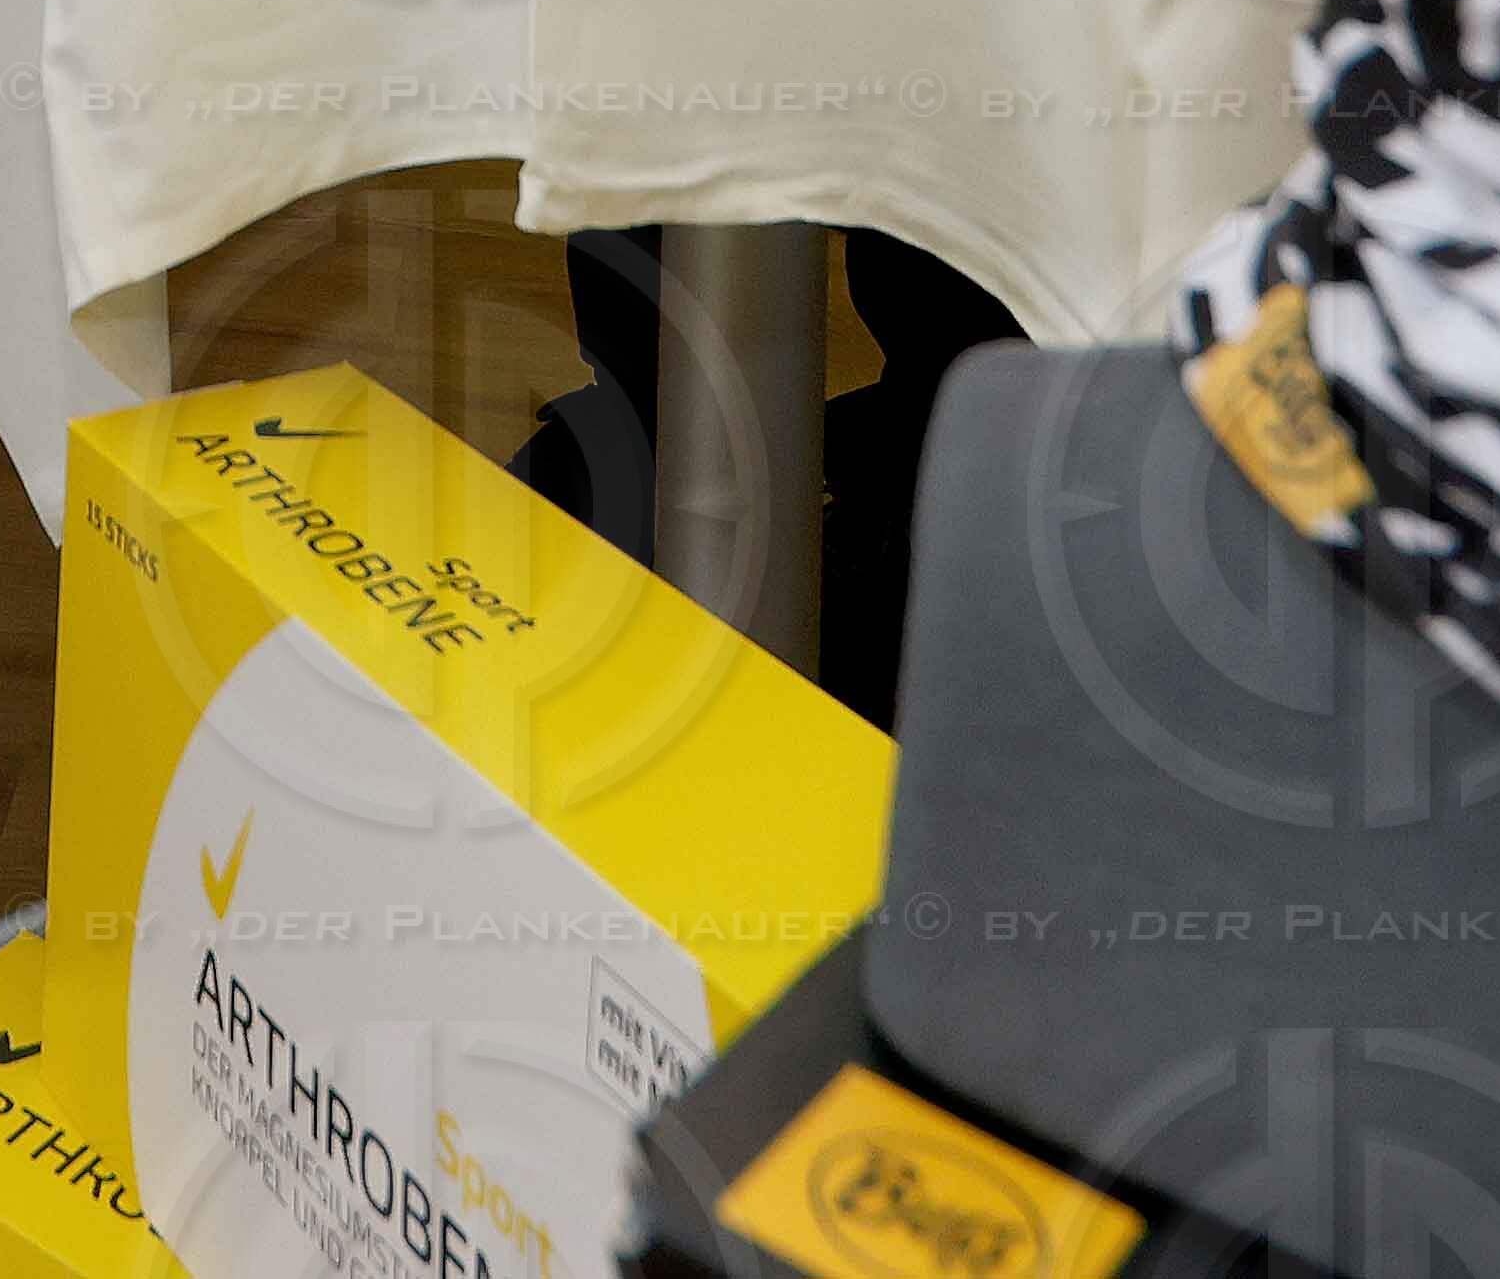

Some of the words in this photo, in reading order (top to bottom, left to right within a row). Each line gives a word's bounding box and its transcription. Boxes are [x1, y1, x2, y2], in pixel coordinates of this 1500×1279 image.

[86, 499, 102, 532] 15
[104, 516, 160, 583] STICKS
[176, 433, 484, 656] ARTHROBENE
[427, 557, 536, 634] Sport
[192, 1020, 232, 1090] DER
[601, 994, 644, 1055] mit
[599, 1038, 640, 1096] mit
[192, 1064, 288, 1209] KNORPEL
[293, 1188, 343, 1269] UND
[436, 1108, 554, 1278] Sport
